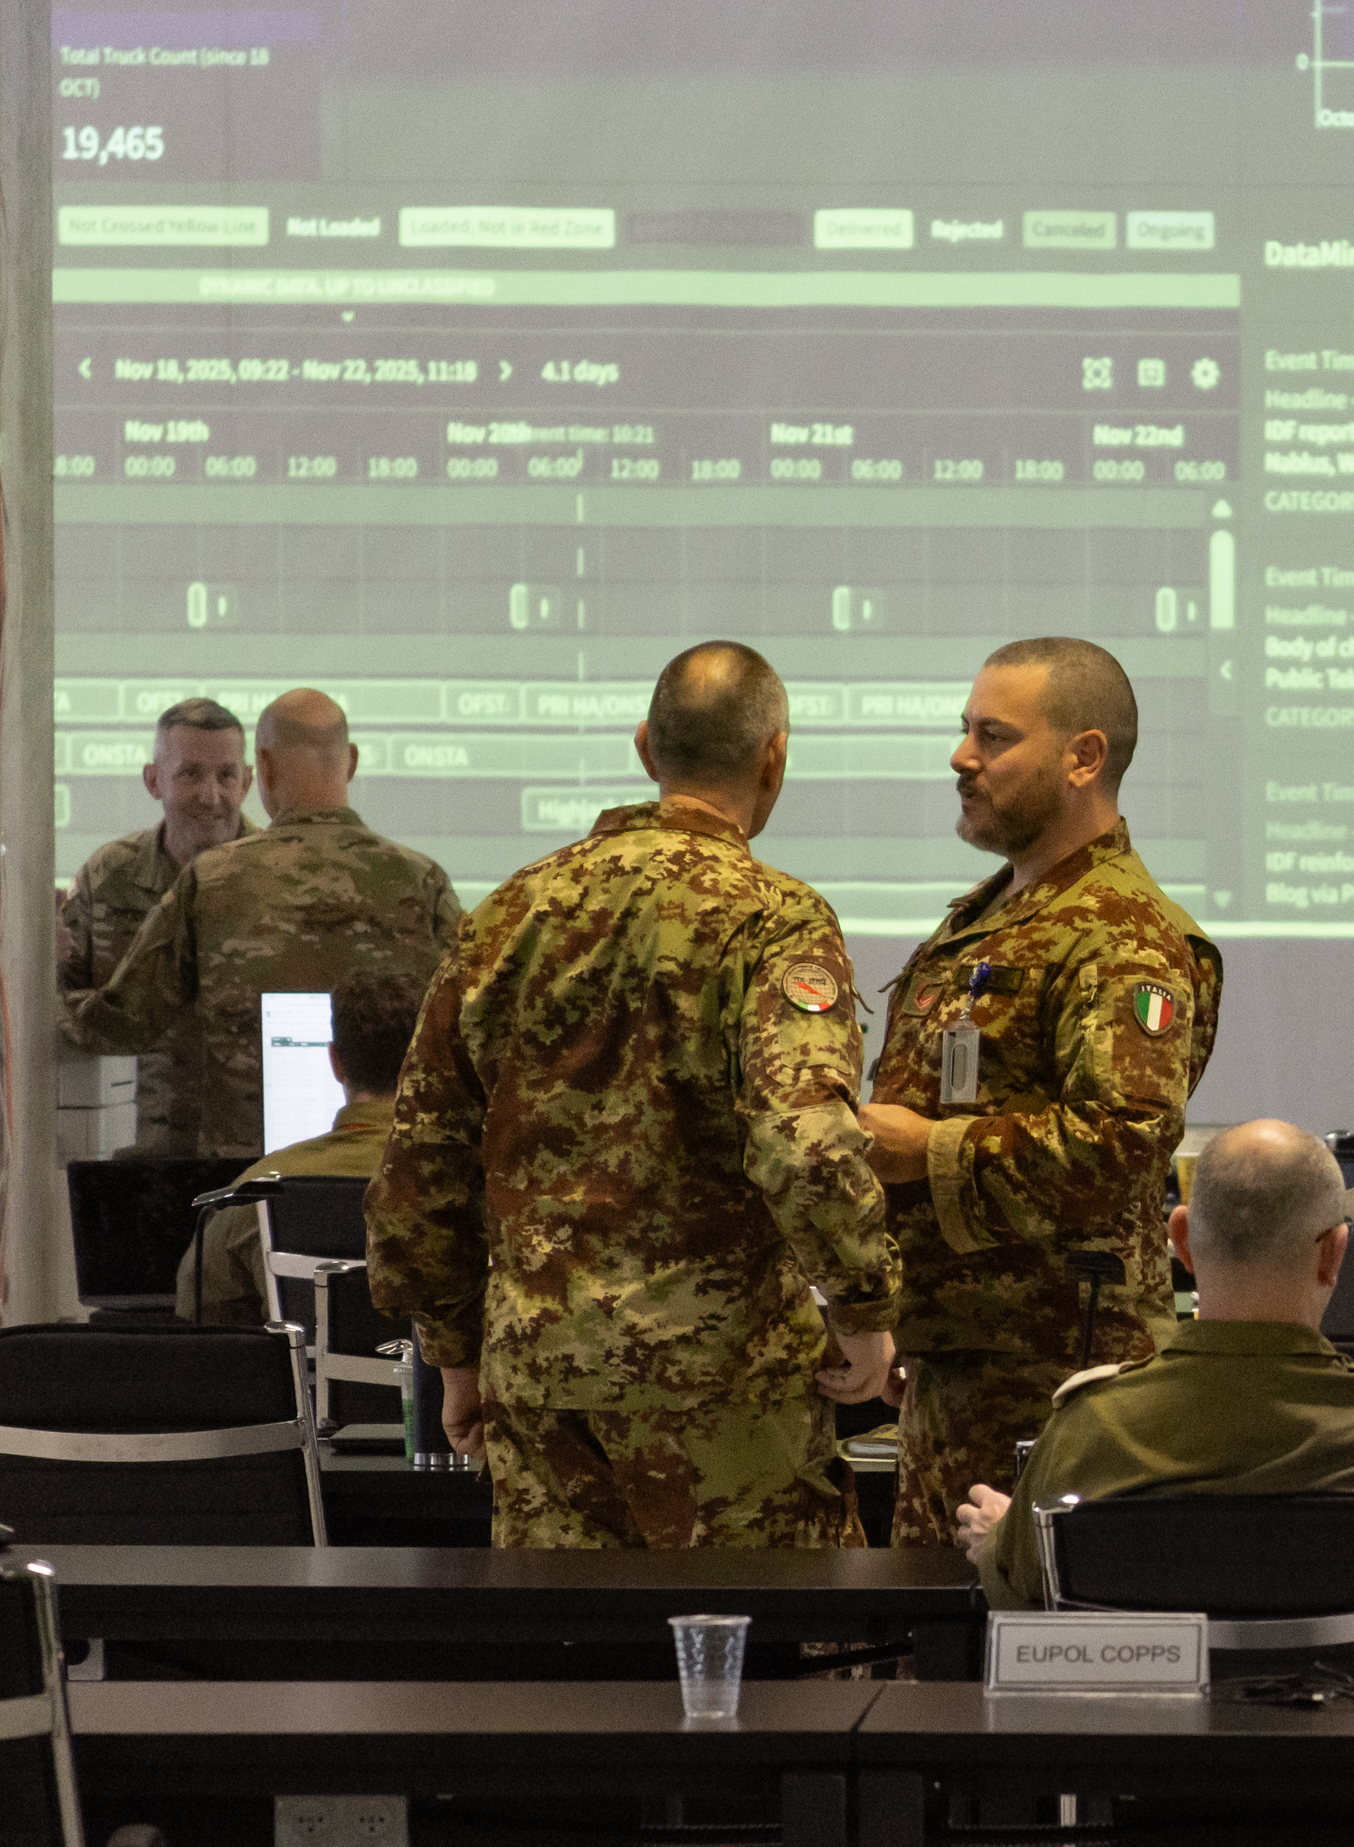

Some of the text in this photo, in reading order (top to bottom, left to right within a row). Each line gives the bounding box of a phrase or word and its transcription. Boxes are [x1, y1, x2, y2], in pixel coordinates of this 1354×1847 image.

[61, 46, 99, 64] Total
[103, 46, 146, 65] Truck
[151, 47, 197, 65] Count
[250, 48, 269, 65] 18
[1295, 53, 1310, 71] 0
[59, 77, 99, 98] OCT)
[62, 126, 164, 166] 19,465
[69, 218, 257, 236] Not Crossed Yellow Line
[287, 217, 380, 237] Not Loaded
[478, 219, 507, 238] Not
[510, 219, 527, 238] in
[530, 219, 560, 238] Red
[563, 219, 604, 238] Zone
[827, 220, 902, 237] Delivered
[931, 218, 1003, 242] Rejected
[1032, 220, 1105, 238] Canceled
[1136, 221, 1205, 242] Ongoing
[1265, 350, 1317, 371] Event
[115, 359, 478, 384] Nov 18, 2025, 09:22 Nov 22, 2025, 11:18
[541, 360, 620, 385] 4.1 days
[1265, 389, 1347, 410] Headline
[125, 421, 210, 441] Nov 19th
[447, 422, 486, 443] Nov
[770, 423, 853, 444] Nov 21st
[1093, 424, 1184, 446] Nov 22nd
[1265, 420, 1296, 441] IDF
[54, 456, 1145, 480] 8:00 00:00 12:00 00:00 12:00 00:00 12:00 00:00
[1265, 452, 1335, 476] Nablus,
[1265, 636, 1313, 661] Body
[1316, 636, 1337, 658] of
[1265, 668, 1323, 689] Public
[404, 747, 468, 767] ONSTA
[1265, 852, 1296, 872] IDF
[1141, 985, 1171, 1001] ITALIA
[1016, 1645, 1181, 1664] EUPOL COPPS
